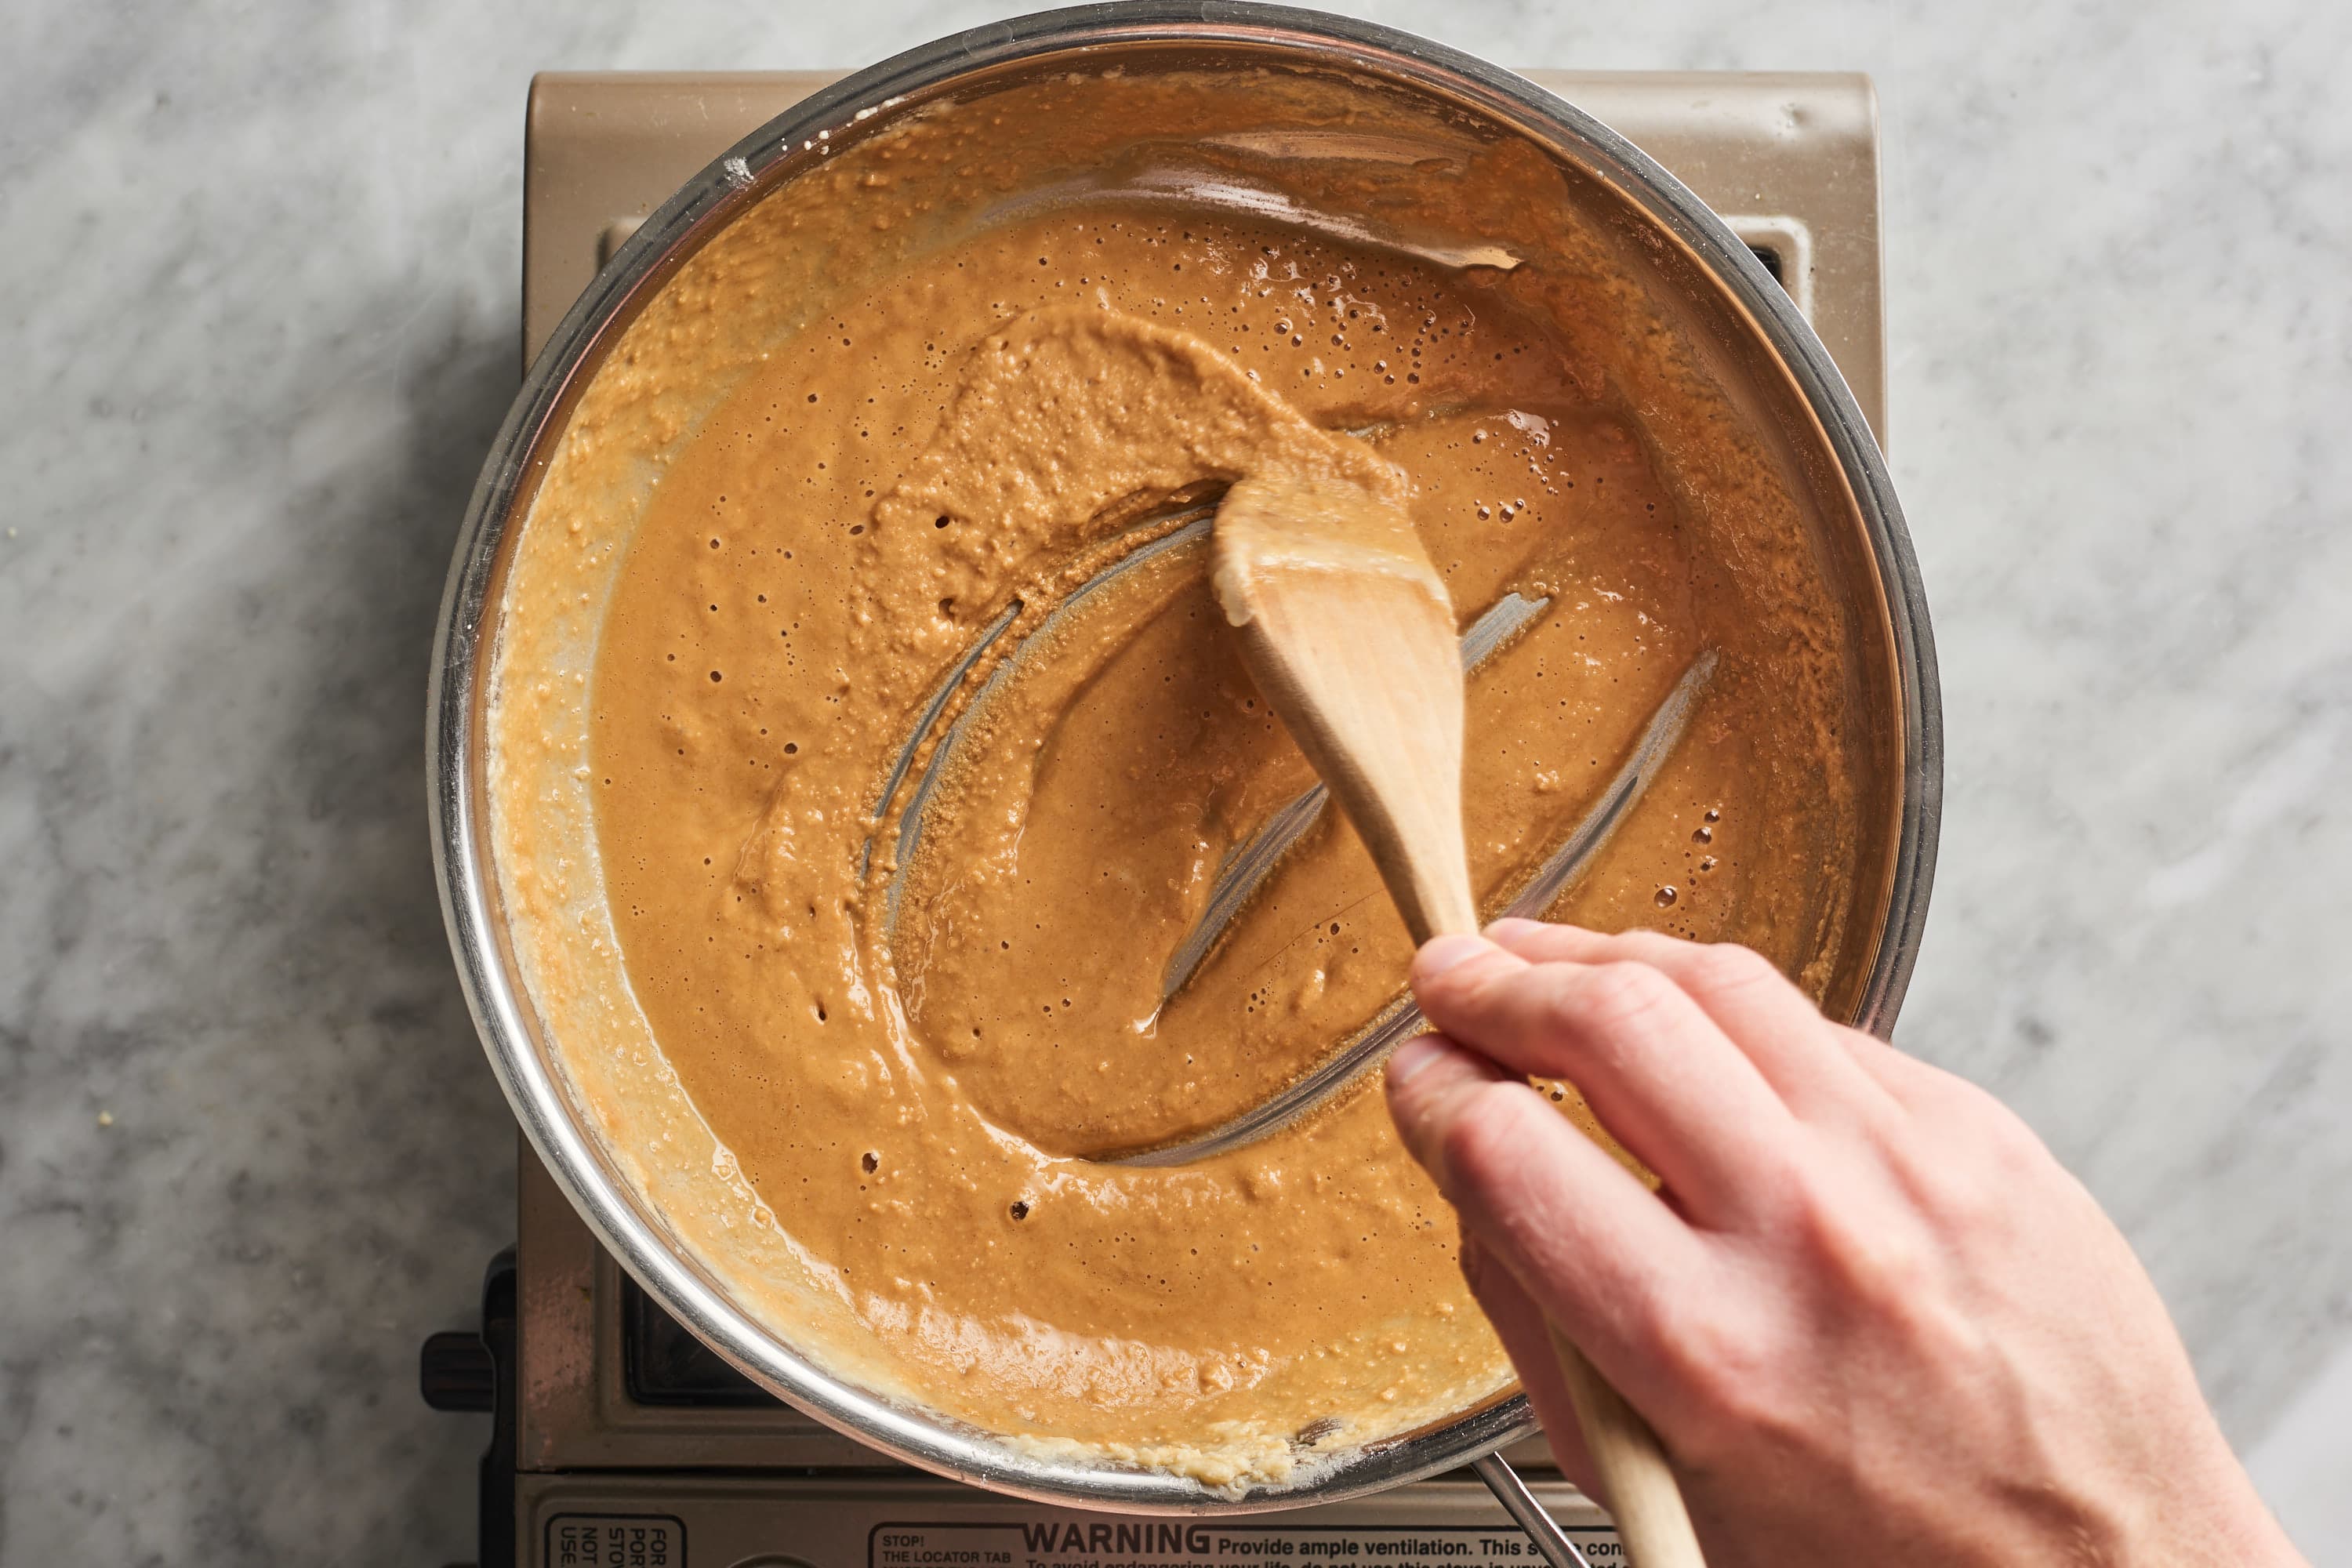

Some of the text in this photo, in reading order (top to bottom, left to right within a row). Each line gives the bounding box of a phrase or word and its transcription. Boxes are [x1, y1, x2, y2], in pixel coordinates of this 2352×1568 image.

[582, 1526, 597, 1565] NOT
[630, 1528, 645, 1568] POR
[650, 1528, 666, 1566] FOR
[883, 1535, 924, 1547] STOP!
[883, 1551, 1011, 1563] THE LOCATOR TAB
[1022, 1523, 1210, 1554] WARNING
[1218, 1538, 1294, 1555] Provide
[1299, 1538, 1359, 1559] ample
[1364, 1538, 1473, 1556] ventilation.
[1479, 1539, 1521, 1556] This
[1587, 1543, 1625, 1556] con
